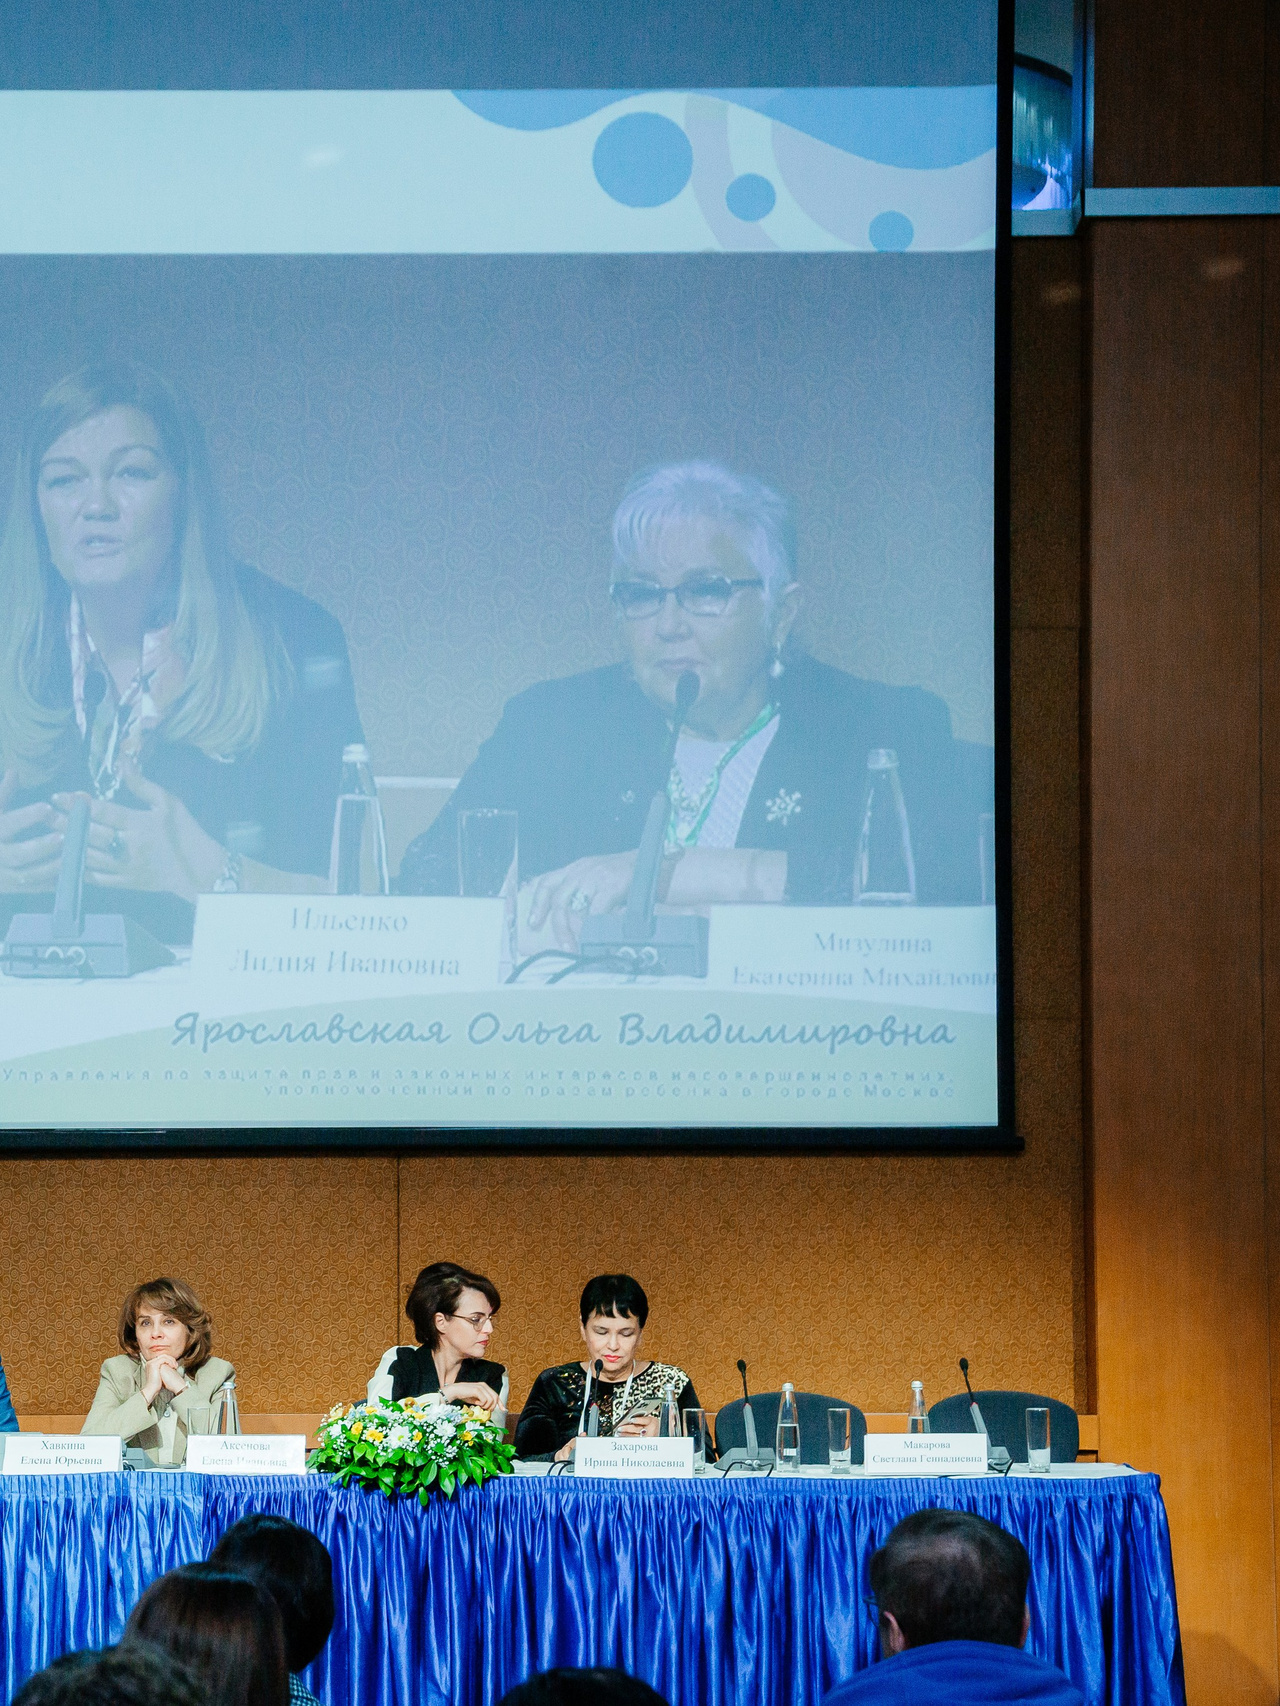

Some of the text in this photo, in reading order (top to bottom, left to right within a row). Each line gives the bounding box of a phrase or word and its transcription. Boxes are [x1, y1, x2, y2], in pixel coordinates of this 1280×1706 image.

[291, 907, 409, 932] Ильенко
[814, 932, 932, 957] Мизулина
[228, 949, 461, 976] Лидия Ивановна
[732, 966, 854, 988] Екатерина
[171, 1012, 957, 1055] Ярославская Ольга Владимировна
[3, 1068, 150, 1083] Управления
[164, 1069, 189, 1081] по
[395, 1069, 511, 1081] законных
[486, 1084, 511, 1096] по
[765, 1085, 853, 1099] городе
[864, 1084, 956, 1098] Москве
[41, 1440, 85, 1450] Хавкина
[220, 1440, 271, 1451] Аксенова
[611, 1441, 658, 1453] Захарова
[903, 1440, 951, 1450] Макарова
[20, 1456, 102, 1467] Елена Юрьевна
[584, 1457, 685, 1469] Ирина Николаевна
[872, 1454, 982, 1463] Светлана Геннадиевна
